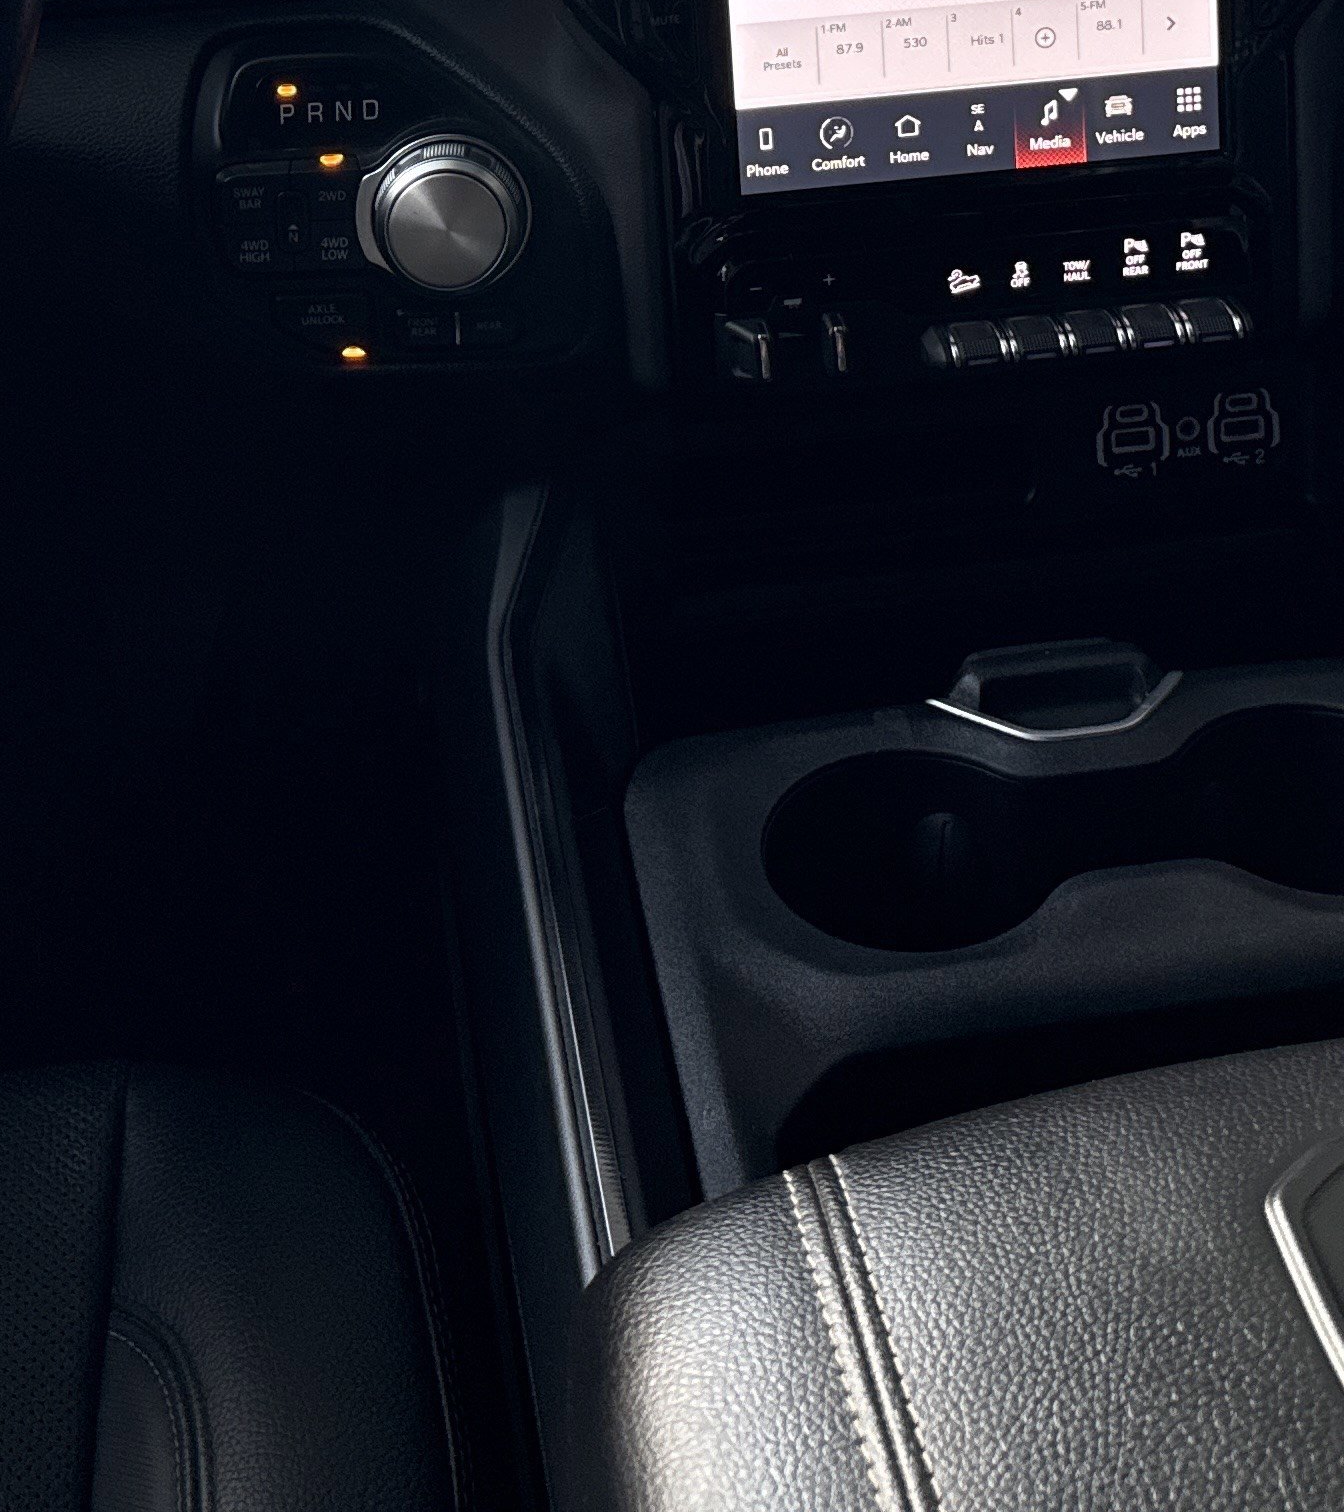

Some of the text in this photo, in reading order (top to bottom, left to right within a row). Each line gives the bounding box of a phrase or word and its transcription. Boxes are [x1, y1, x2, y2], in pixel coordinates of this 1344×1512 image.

[1080, 0, 1106, 11] 5-FM
[950, 13, 958, 23] 3
[1014, 7, 1022, 17] 4
[821, 22, 847, 34] 1-FM
[885, 16, 913, 29] 2-AM
[1096, 18, 1123, 31] 88.1
[903, 36, 928, 49] 530
[970, 33, 1005, 47] Hits 1
[776, 47, 789, 58] All
[836, 42, 864, 55] 87.9
[763, 59, 803, 72] Presets
[1095, 128, 1146, 145] Vehicle
[1173, 124, 1207, 139] Apps
[1029, 135, 1072, 151] Media
[966, 142, 995, 157] Nav
[811, 154, 866, 172] Comfort
[889, 150, 930, 165] Home
[746, 162, 790, 178] Phone
[233, 187, 265, 198] SWAY
[318, 190, 347, 202] 2WD
[239, 199, 262, 209] BAR
[240, 239, 269, 251] 4WD
[320, 237, 349, 248] 4WD
[239, 251, 271, 263] HIGH
[321, 249, 349, 261] LOW
[1125, 254, 1146, 266] OFF
[1182, 248, 1202, 260] OFF
[1062, 259, 1091, 272] TOW/
[1122, 265, 1150, 277] REAR
[1175, 258, 1209, 272] FRONT
[1063, 270, 1092, 282] HAUL
[1010, 277, 1031, 289] OFF
[1176, 445, 1202, 458] AUX
[1255, 448, 1265, 465] 2
